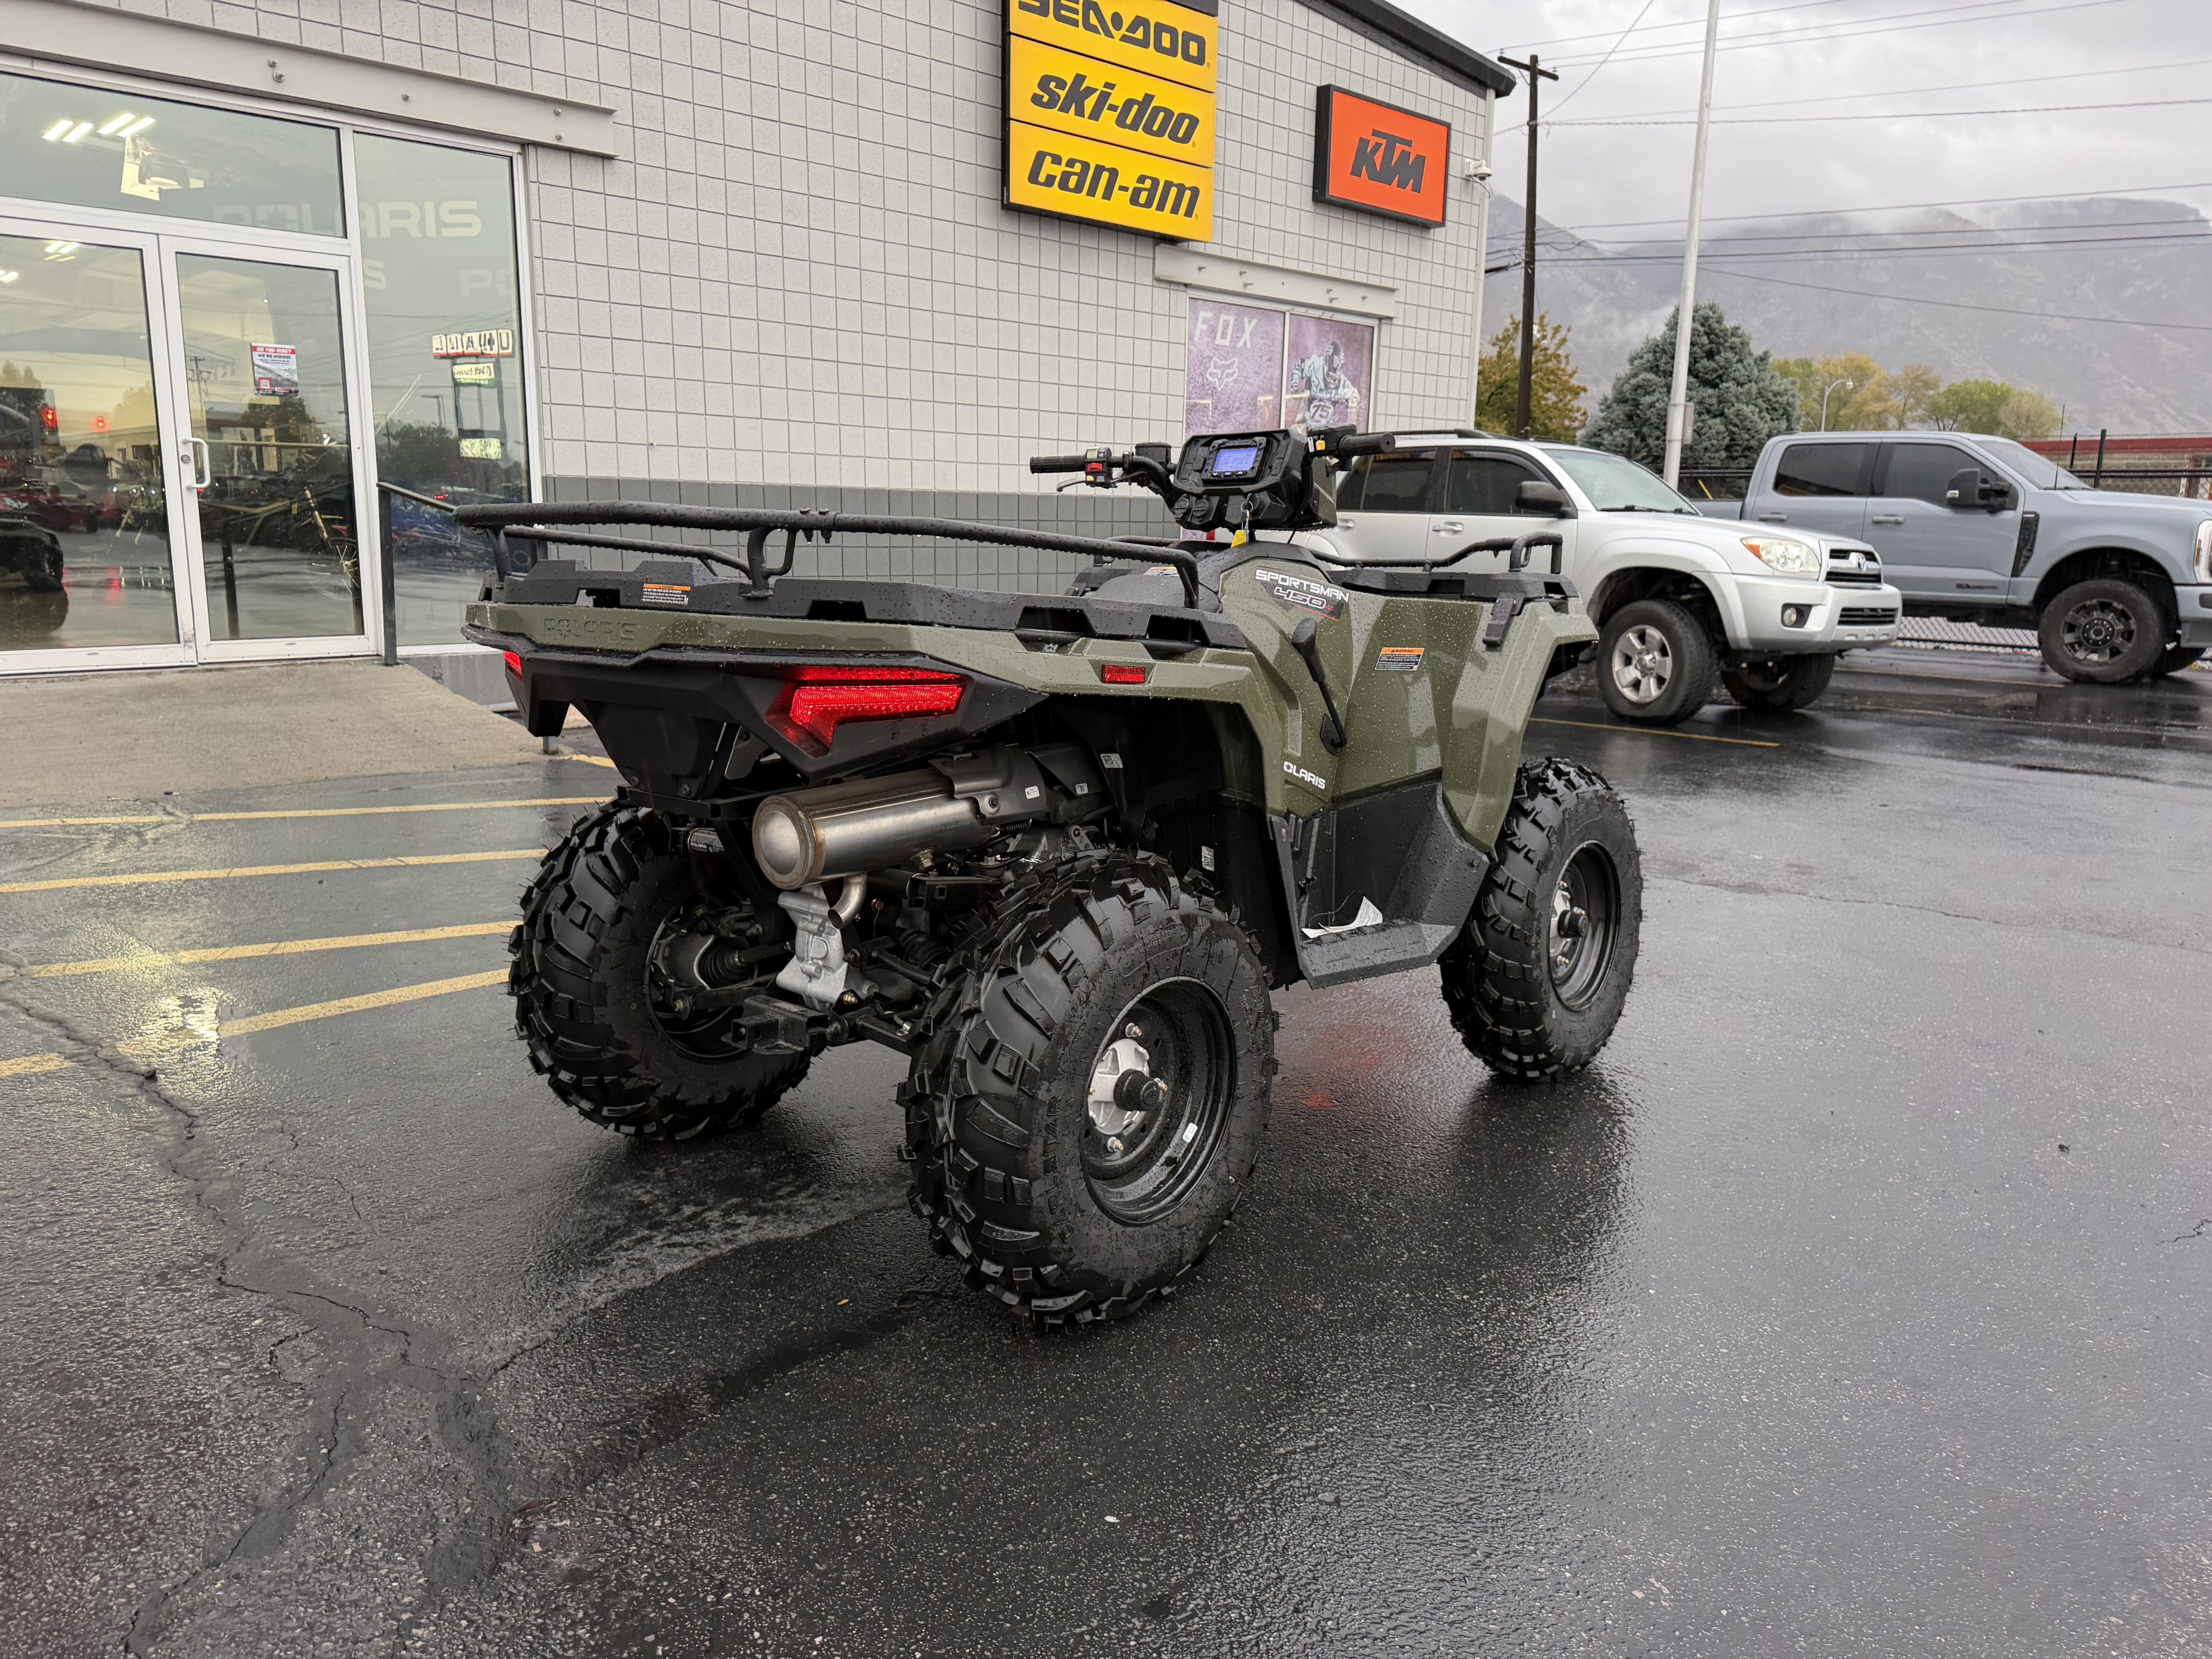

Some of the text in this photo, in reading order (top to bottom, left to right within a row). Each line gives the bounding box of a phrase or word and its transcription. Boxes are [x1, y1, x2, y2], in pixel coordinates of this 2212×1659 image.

[1030, 72, 1200, 144] ski-doo
[1350, 129, 1426, 194] KTM
[1027, 150, 1200, 218] can-am
[1194, 311, 1257, 348] FOX
[1312, 404, 1331, 419] 75
[1255, 569, 1349, 603] SPORTSMAN
[1274, 586, 1326, 609] 450
[1283, 761, 1326, 790] OLARIS
